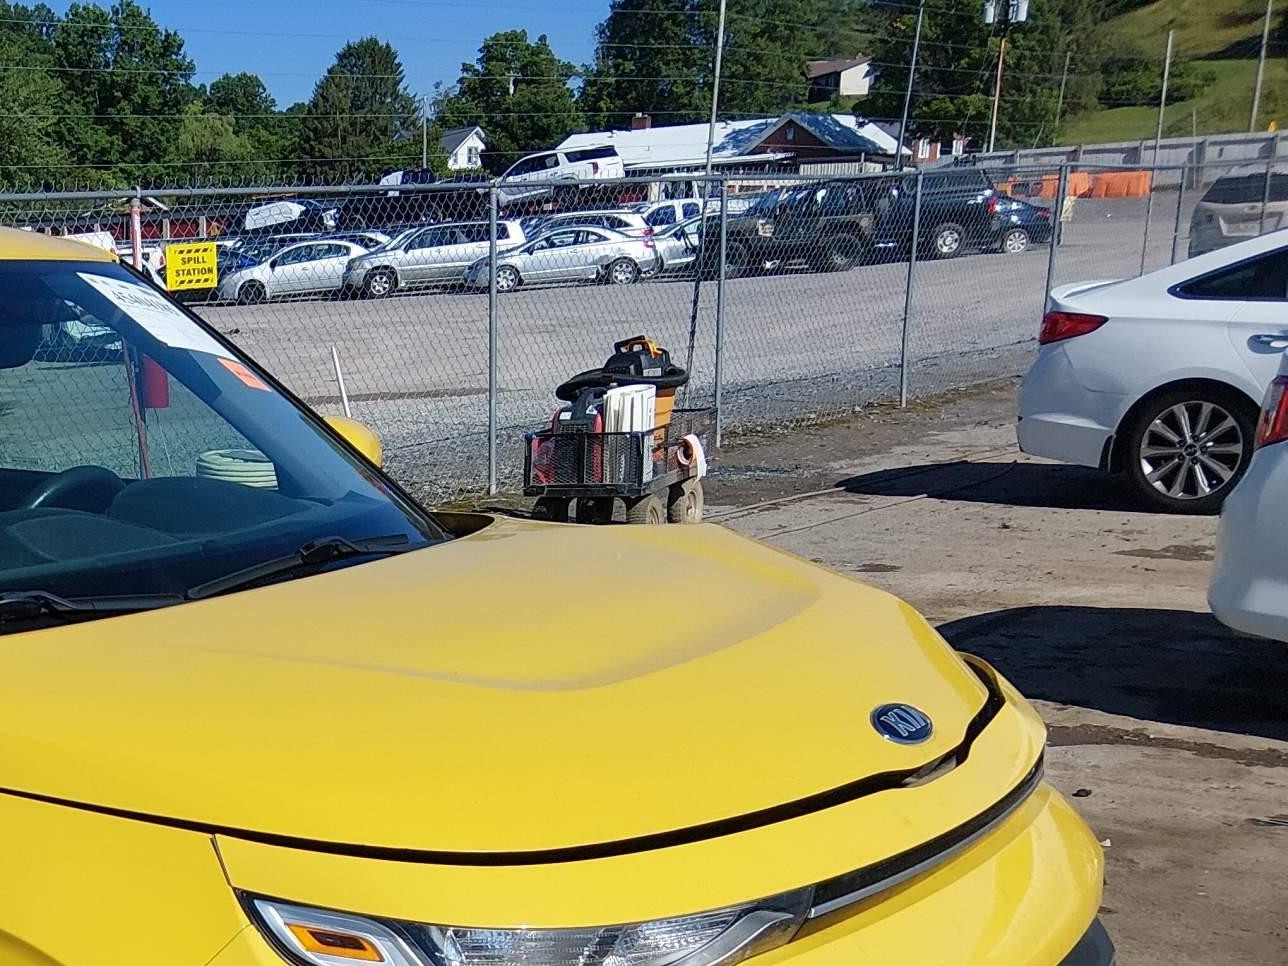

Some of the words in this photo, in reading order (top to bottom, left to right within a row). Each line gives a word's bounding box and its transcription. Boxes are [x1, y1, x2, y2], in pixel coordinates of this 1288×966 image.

[181, 256, 207, 265] SPILL
[175, 267, 213, 278] STATION
[880, 706, 928, 737] KIA
